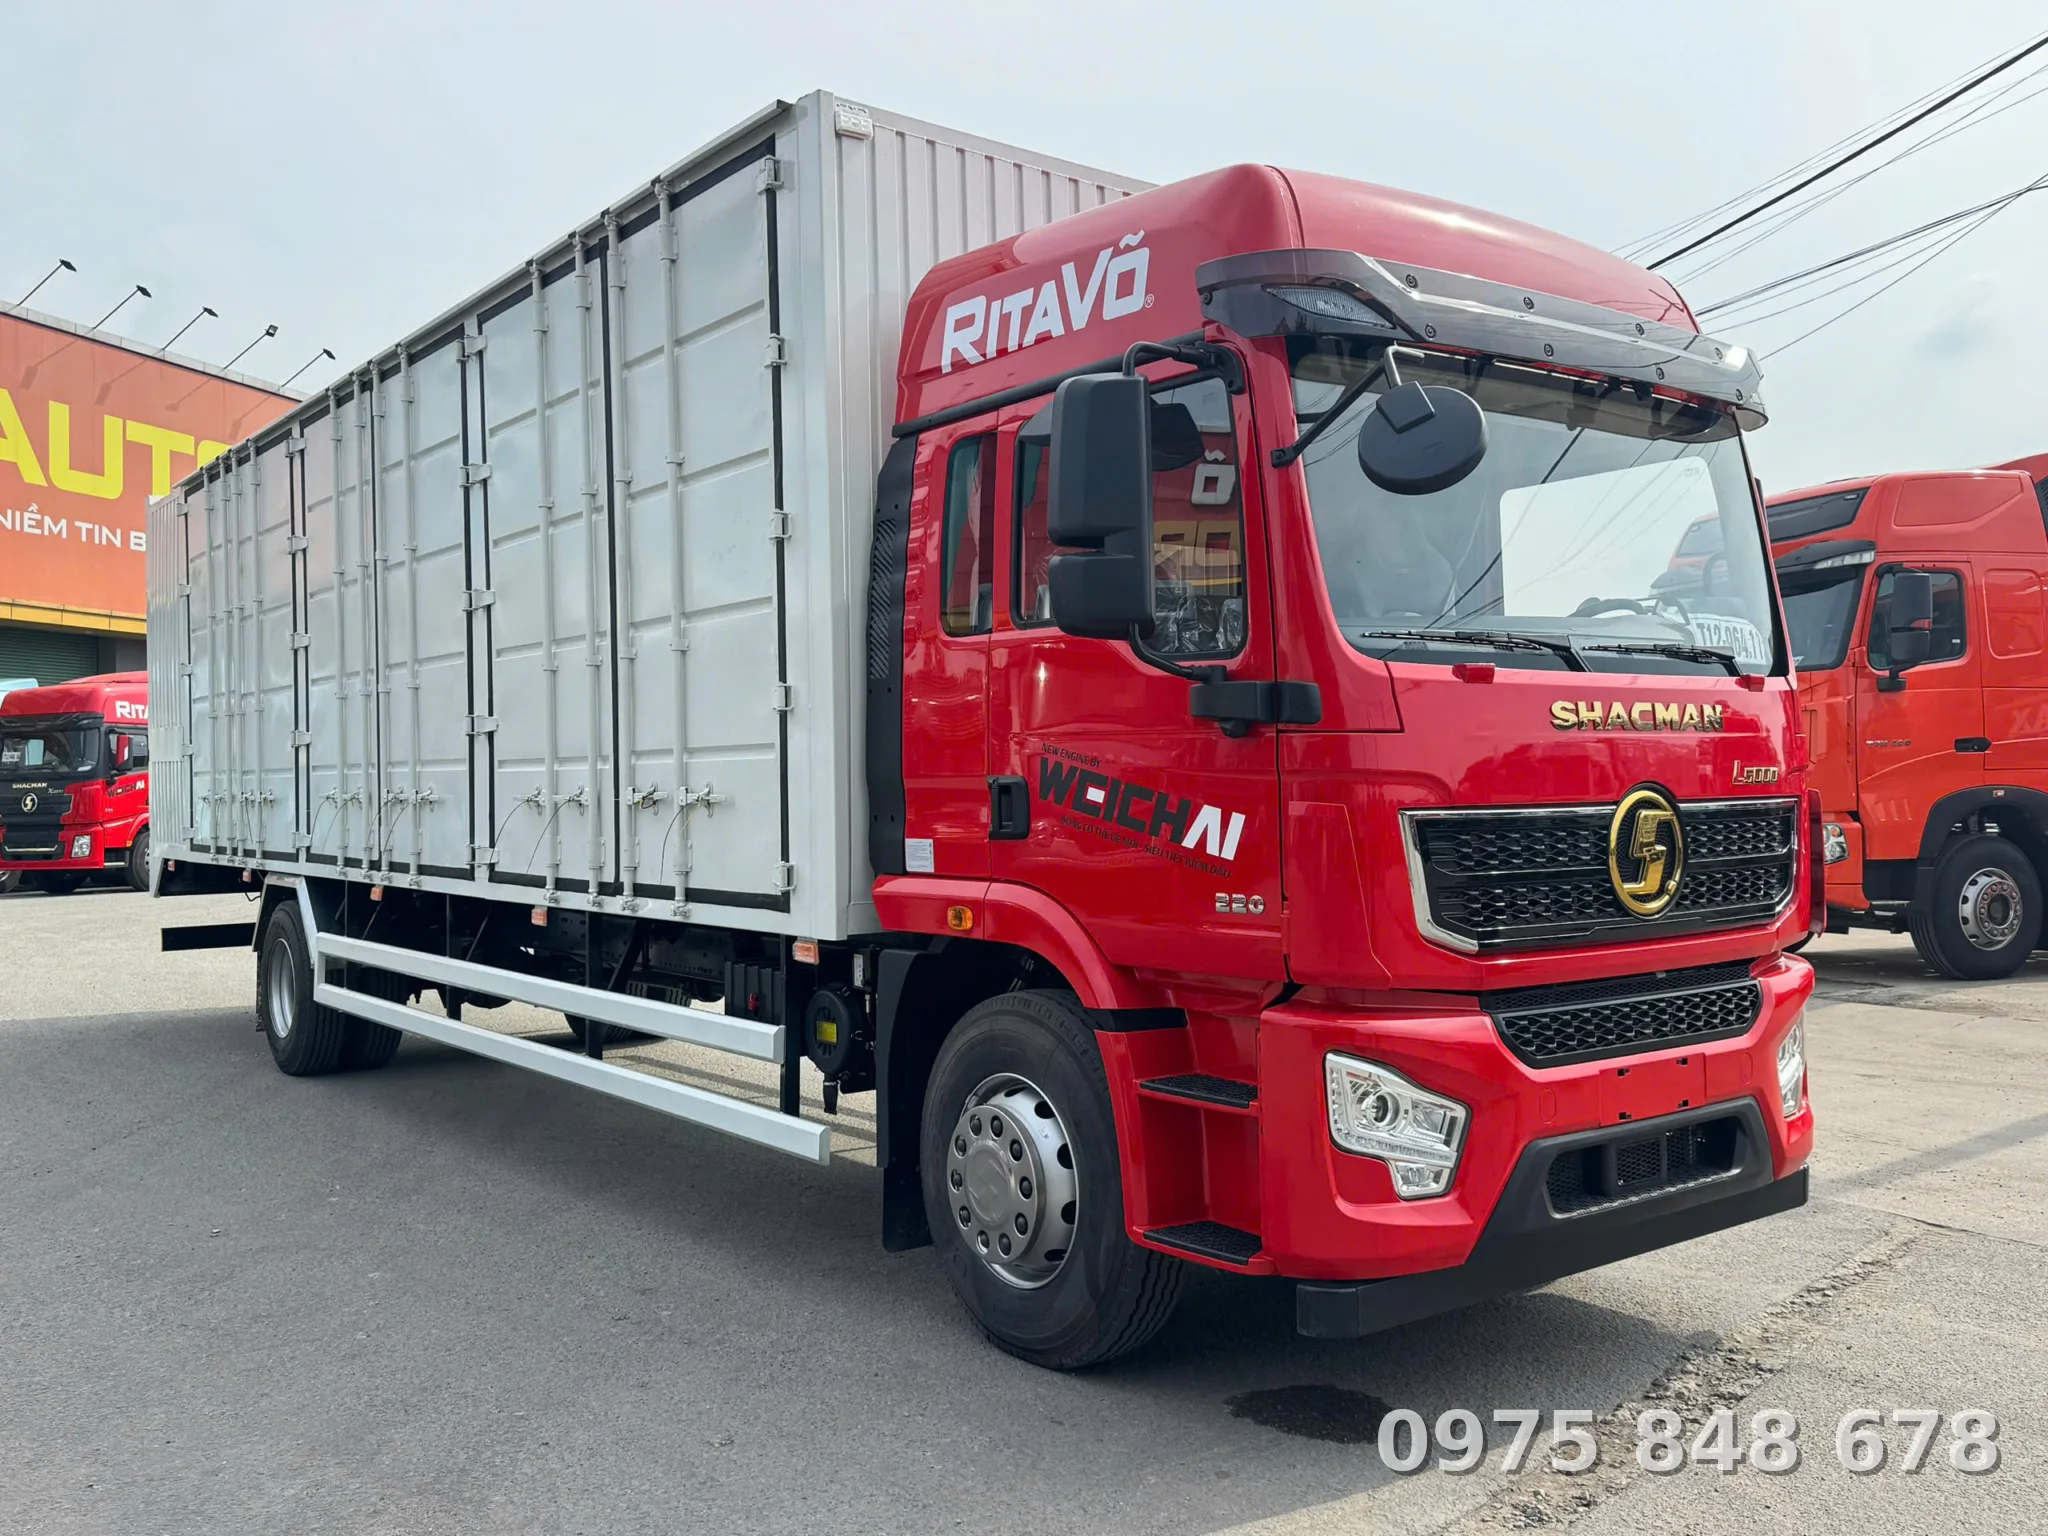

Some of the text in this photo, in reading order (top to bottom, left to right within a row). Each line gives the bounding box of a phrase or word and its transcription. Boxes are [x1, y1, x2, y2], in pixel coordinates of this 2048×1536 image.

[941, 230, 1149, 374] RITAVÕ
[74, 520, 122, 548] TIN
[1550, 700, 1723, 732] SHACMAN
[1041, 742, 1102, 767] NEW ENGINE BY
[1039, 756, 1246, 861] WEICHAI
[1215, 892, 1265, 916] 220
